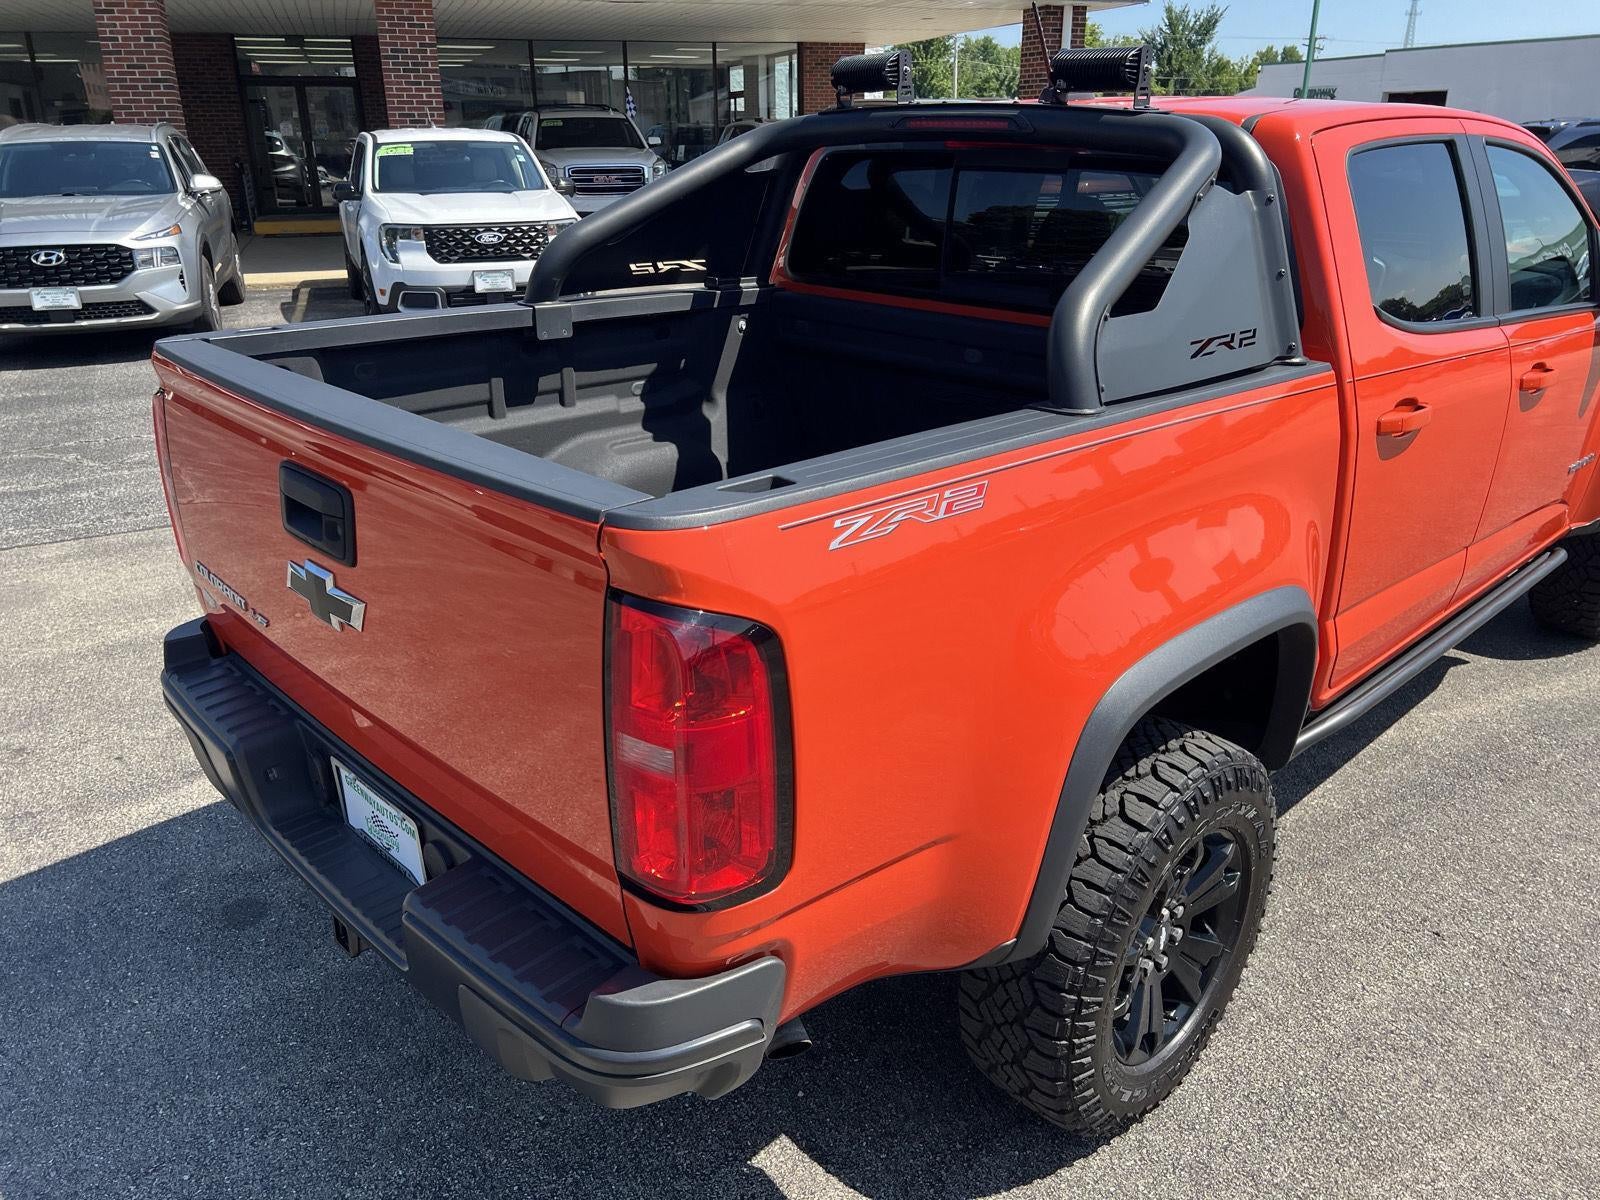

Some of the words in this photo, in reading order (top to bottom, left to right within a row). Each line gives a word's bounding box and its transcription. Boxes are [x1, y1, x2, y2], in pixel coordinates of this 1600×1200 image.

[1293, 87, 1337, 99] GENWAY
[1190, 328, 1257, 360] ZR2
[829, 480, 989, 551] ZR2
